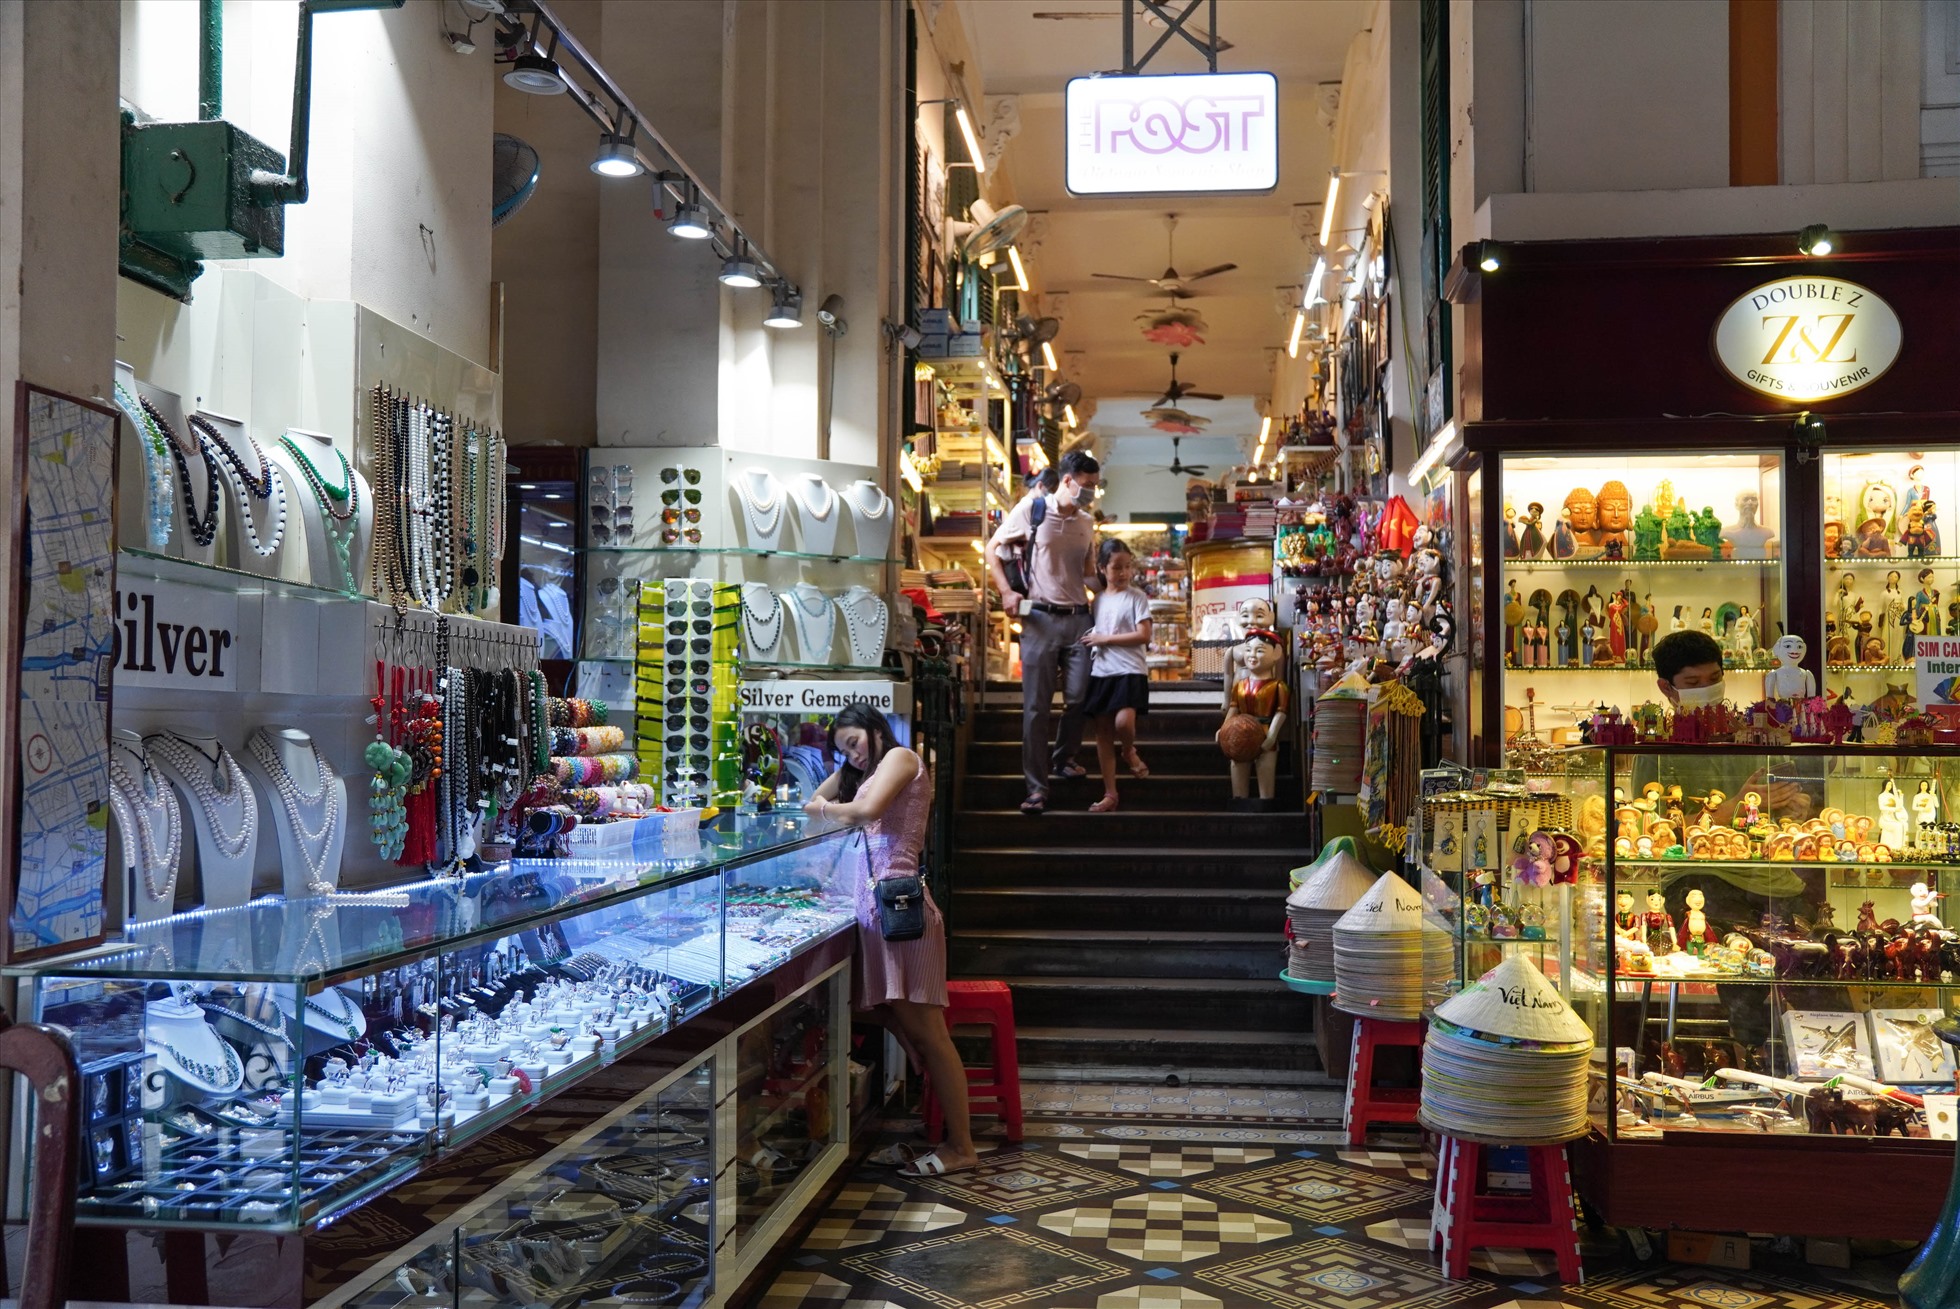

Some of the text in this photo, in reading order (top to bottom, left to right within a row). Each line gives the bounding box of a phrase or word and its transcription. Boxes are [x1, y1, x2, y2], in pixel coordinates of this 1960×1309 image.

[1094, 95, 1265, 154] POST
[1751, 284, 1864, 311] DOUBLE Z
[1747, 369, 1783, 390] GIFTS
[1804, 366, 1871, 391] SOUVENIR
[1917, 642, 1960, 657] SIM CA
[740, 688, 891, 708] Silver Gemstone
